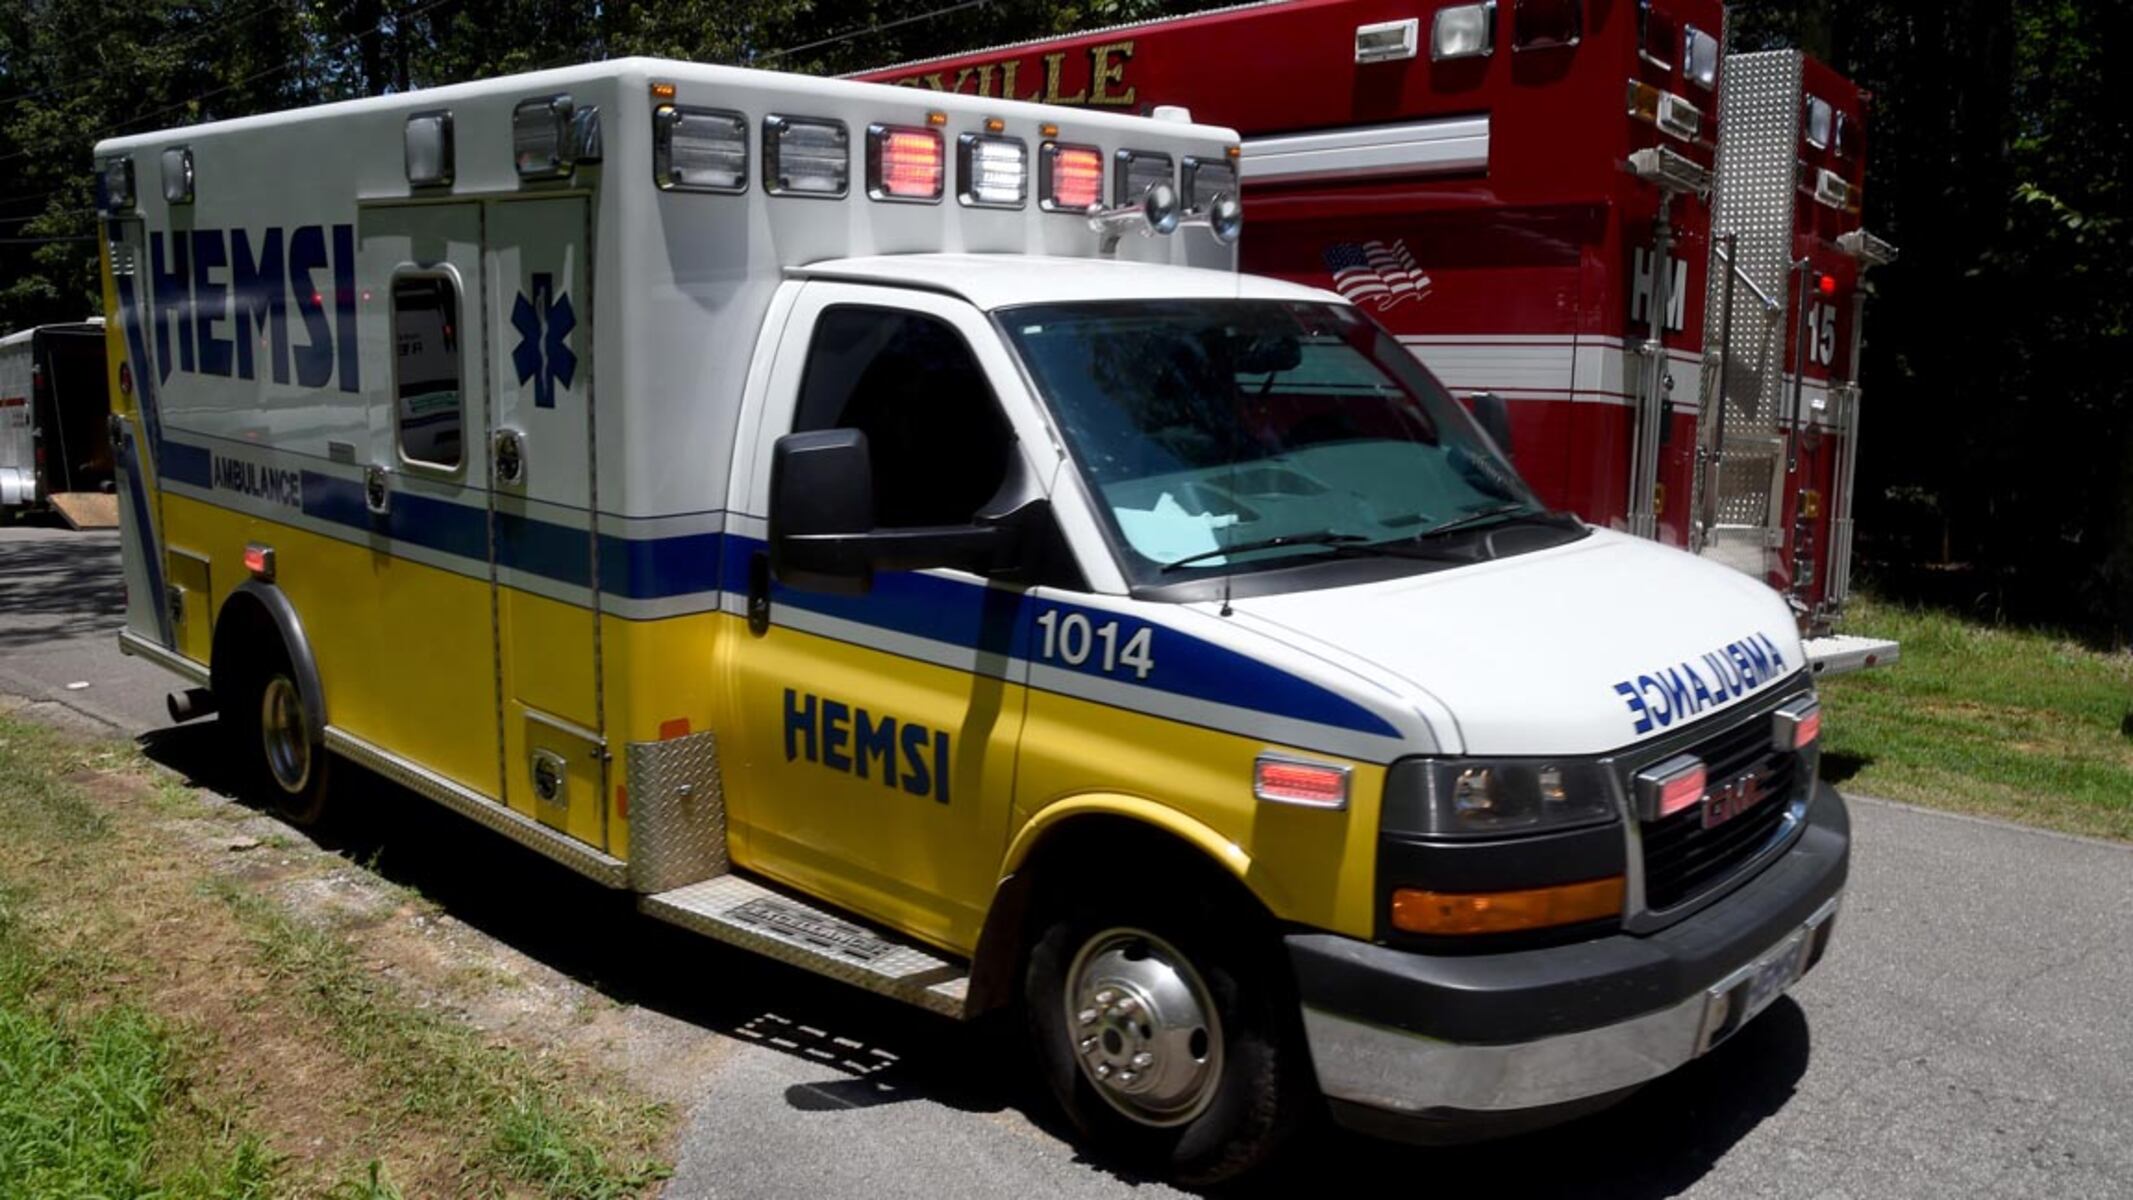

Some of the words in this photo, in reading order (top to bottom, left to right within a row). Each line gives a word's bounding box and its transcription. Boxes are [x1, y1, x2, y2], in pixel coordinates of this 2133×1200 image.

[151, 224, 360, 393] HEMSI
[1808, 301, 1836, 366] 15
[214, 456, 300, 507] AMBULANCE
[1038, 610, 1154, 678] 1014
[783, 688, 950, 804] HEMSI
